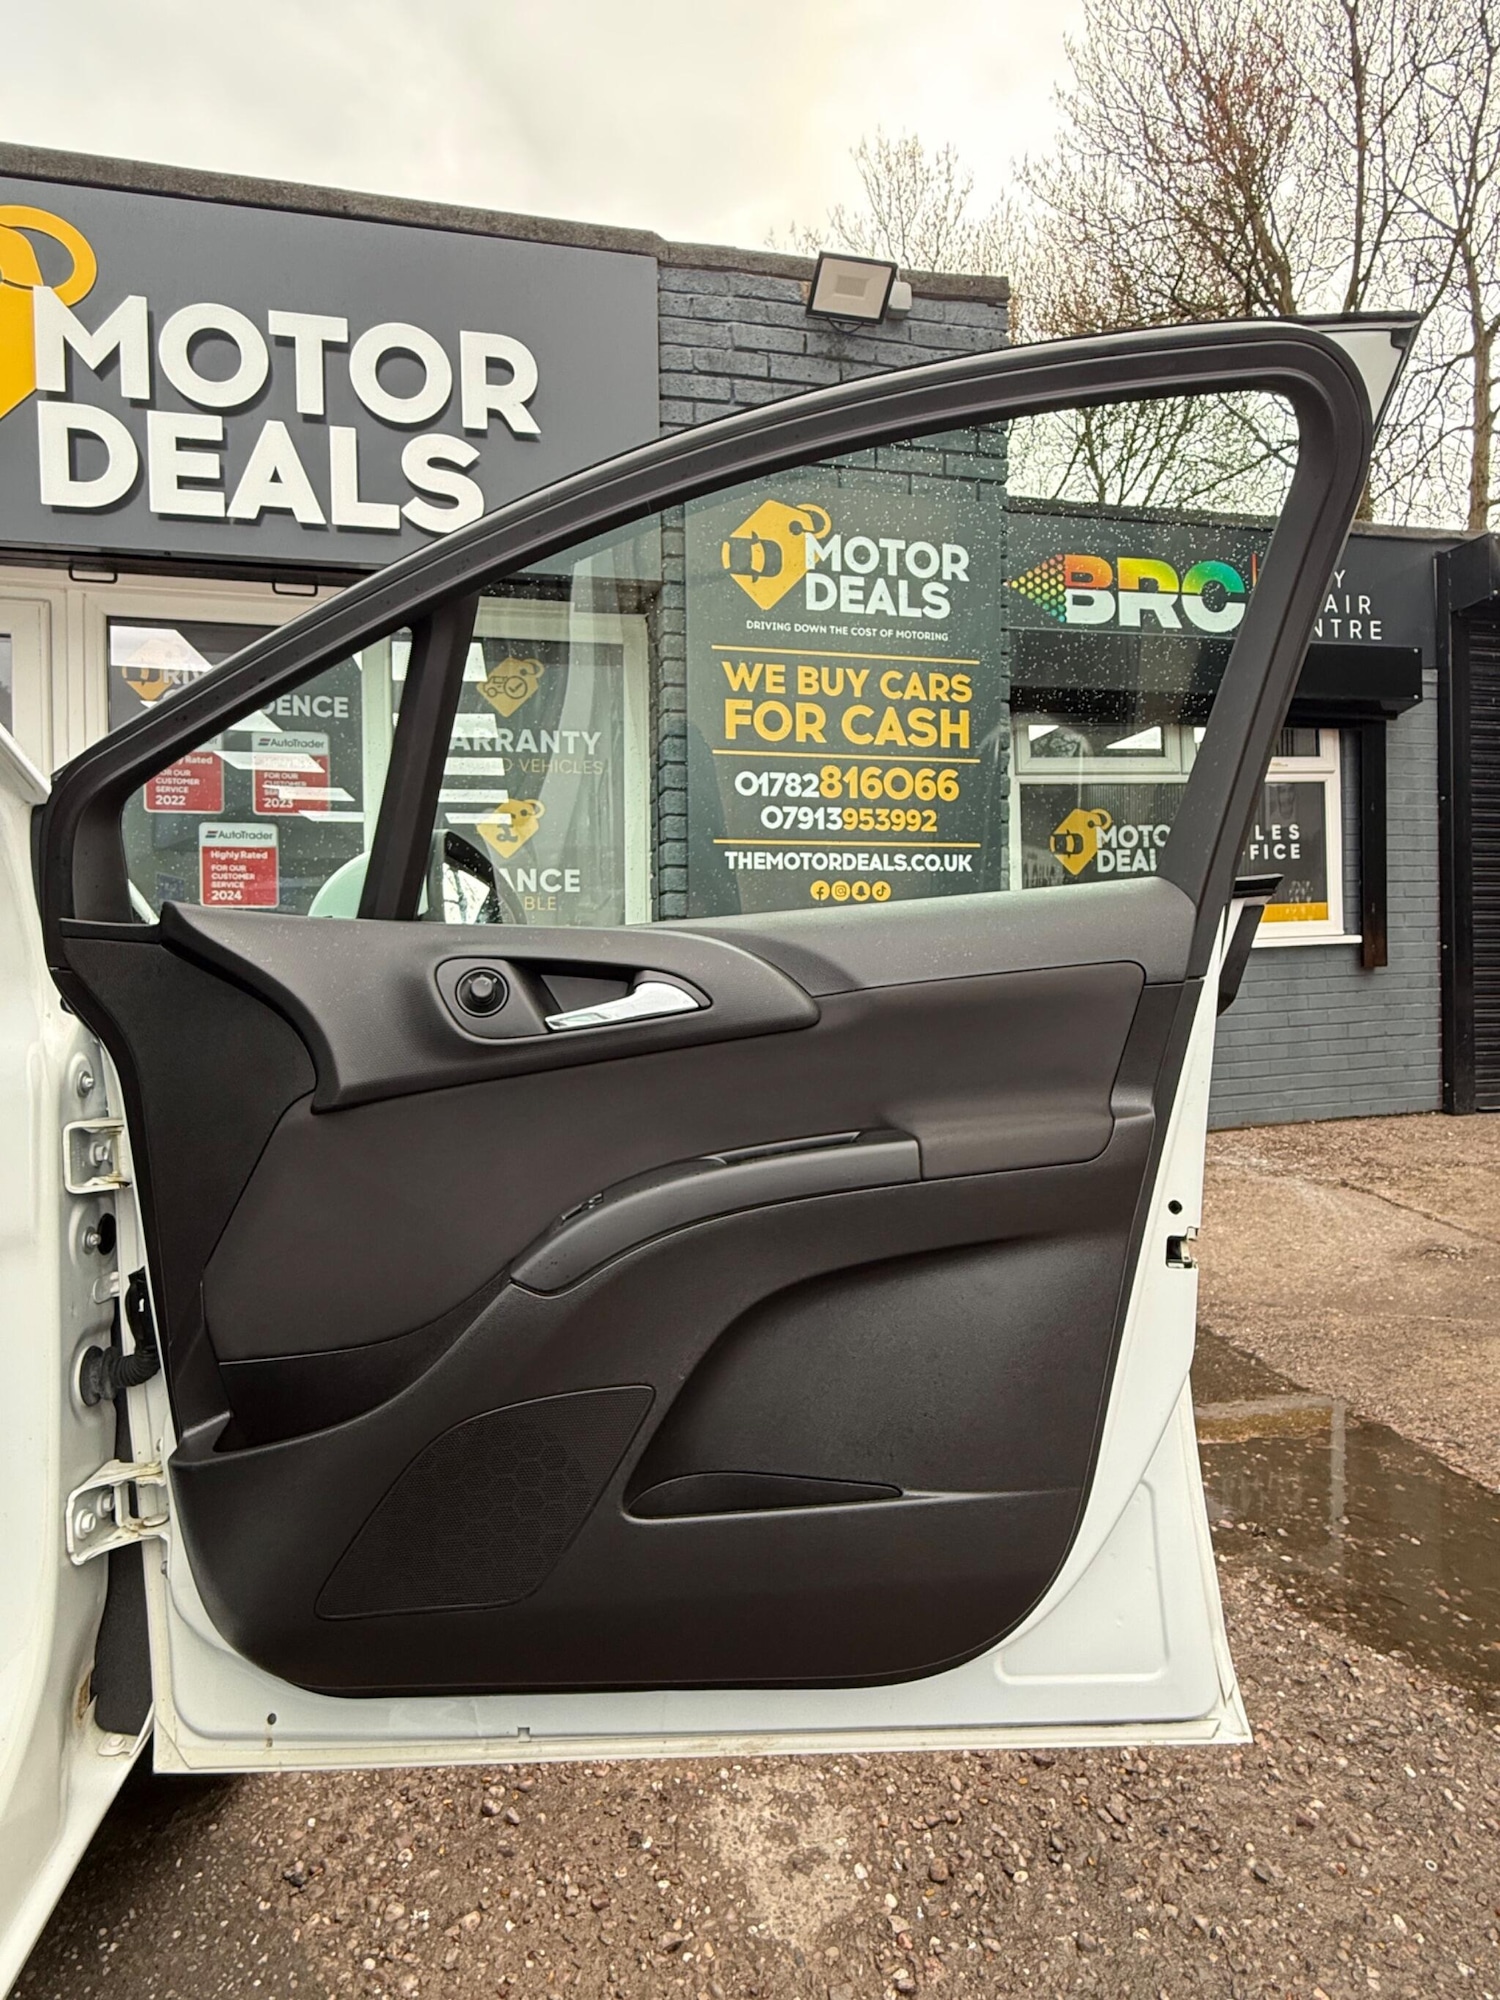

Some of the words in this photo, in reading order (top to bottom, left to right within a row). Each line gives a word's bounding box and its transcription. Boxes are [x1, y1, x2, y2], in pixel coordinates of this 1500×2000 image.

[33, 286, 541, 434] MOTOR
[37, 401, 485, 533] DEALS
[805, 533, 969, 582] MOTOR
[806, 573, 951, 619] DEALS
[1065, 554, 1246, 632] BRC
[1324, 594, 1371, 615] AIR
[746, 620, 791, 632] DRIVING
[794, 623, 827, 634] DOWN
[830, 625, 848, 636] THE
[851, 627, 877, 638] COST
[880, 628, 893, 638] OF
[896, 630, 949, 642] MOTORING
[722, 661, 785, 693] WE
[797, 665, 869, 698] BUY
[880, 671, 973, 703] CARS
[724, 698, 826, 744] FOR
[841, 706, 970, 749] CASH
[270, 738, 325, 749] AutoTrader
[519, 758, 604, 775] VEHICLES
[155, 777, 200, 786] CUSTOMER
[264, 772, 280, 780] FOR
[281, 772, 299, 780] OUR
[734, 765, 960, 802] 01782816066
[155, 786, 189, 794] SERVICE
[155, 795, 186, 806] 2022
[761, 805, 938, 833] 07913953992
[218, 830, 273, 840] AutoTrader
[1096, 824, 1171, 848] MOTO
[1255, 824, 1300, 841] LES
[210, 850, 239, 861] Highly
[240, 850, 268, 860] Rated
[1249, 844, 1301, 860] FICE
[211, 864, 228, 872] FOR
[229, 864, 247, 872] OUR
[724, 850, 973, 873] THEMOTORDEALS.CO.UK
[211, 872, 255, 881] CUSTOMER
[211, 881, 245, 889] SERVICE
[211, 890, 242, 901] 2024
[524, 896, 557, 911] BLE
